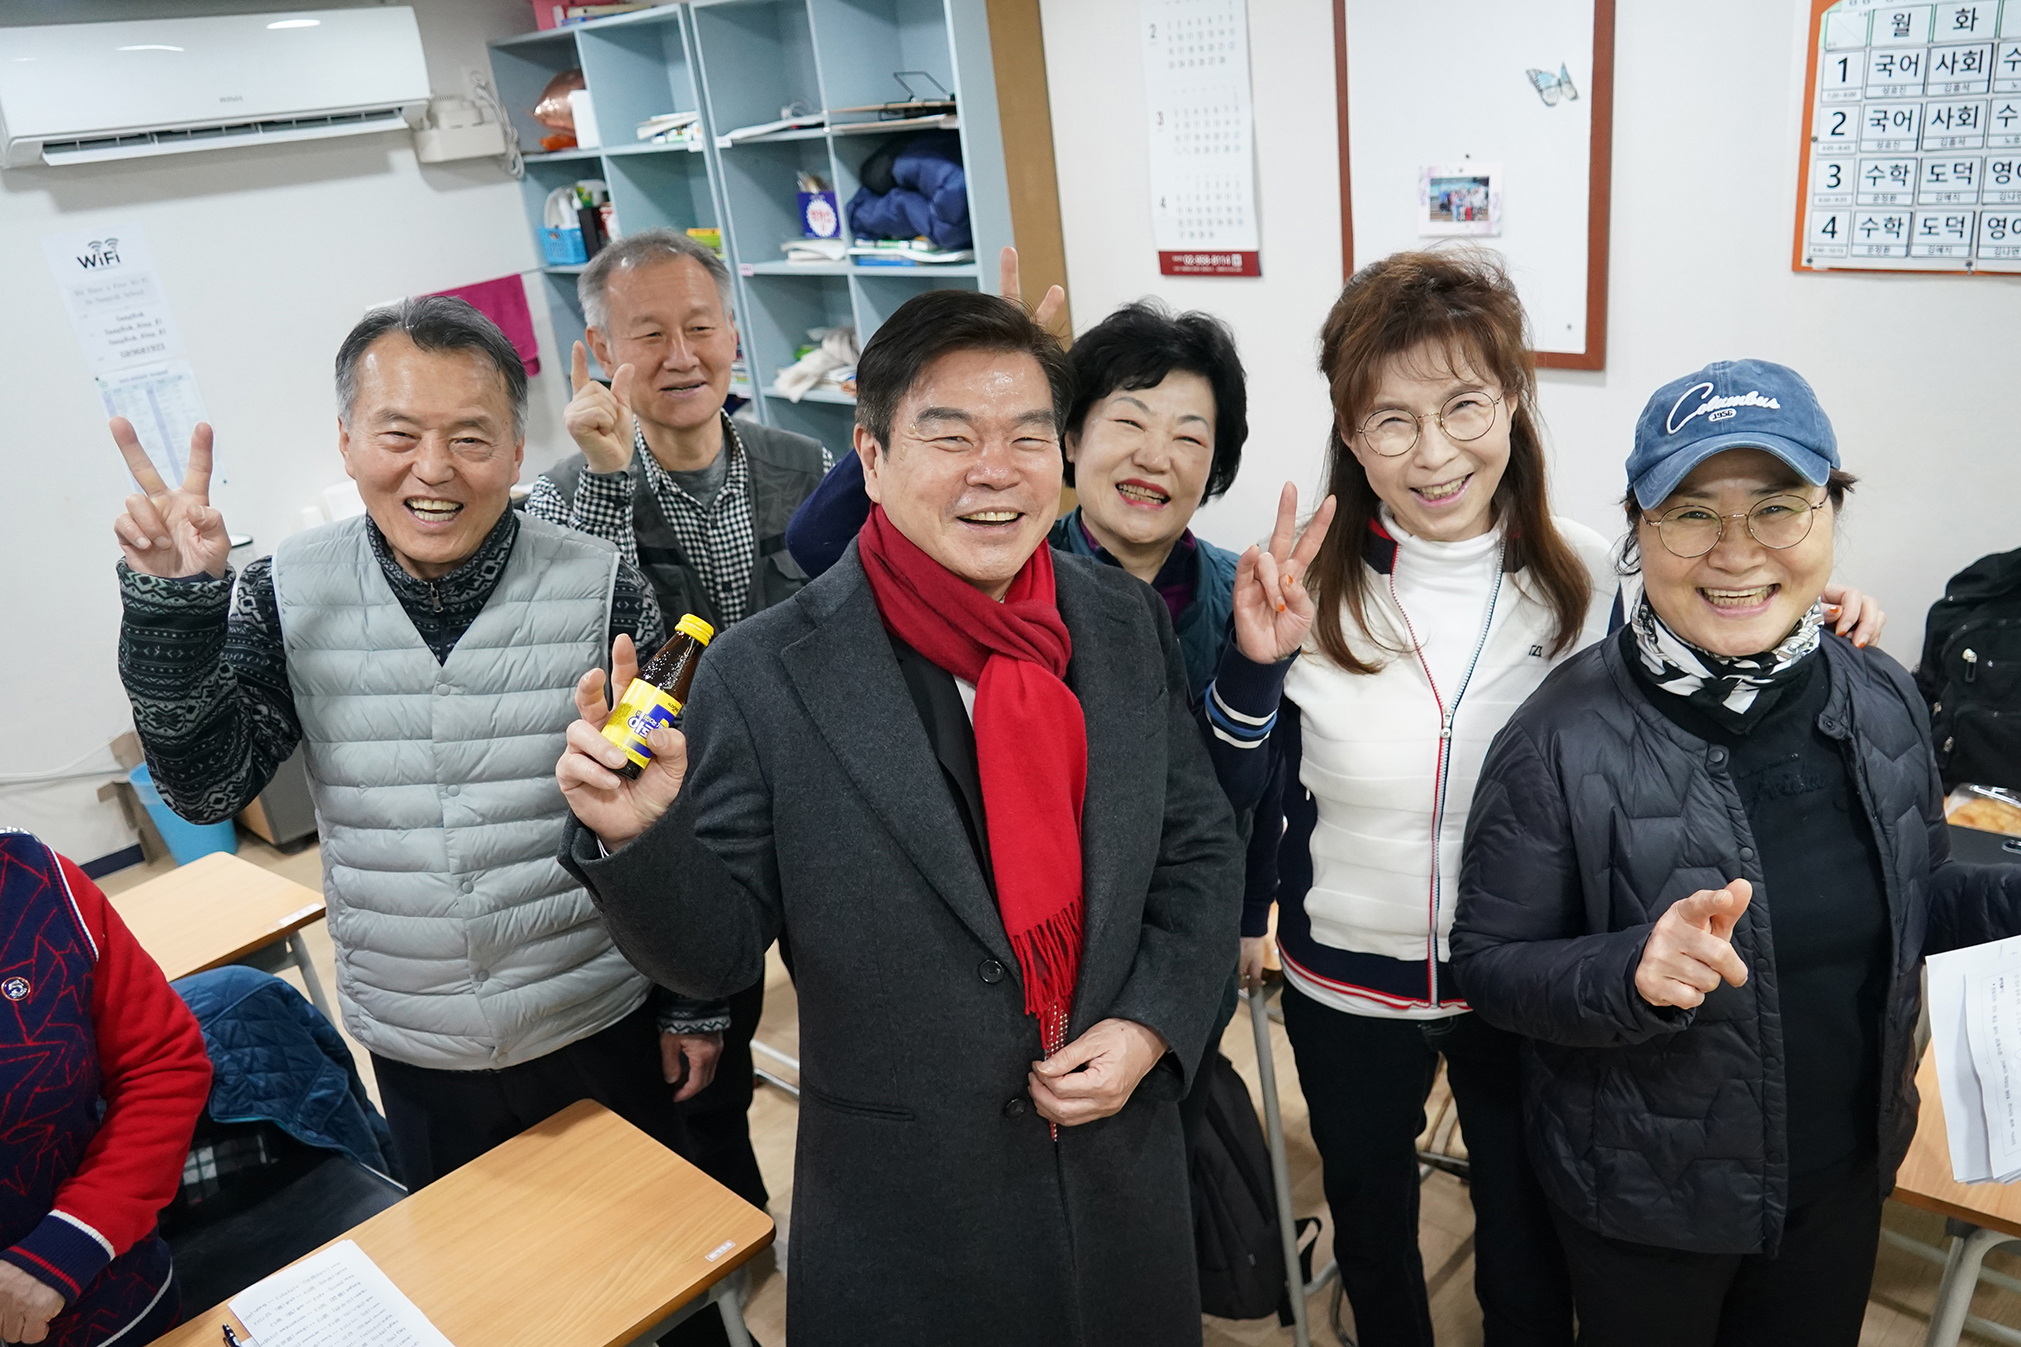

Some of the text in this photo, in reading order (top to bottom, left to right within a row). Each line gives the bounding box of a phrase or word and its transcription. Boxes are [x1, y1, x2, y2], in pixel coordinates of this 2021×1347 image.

[1892, 7, 1978, 37] 월 화
[1837, 57, 1848, 82] 1
[1875, 53, 1920, 77] 국어
[1936, 49, 1983, 75] 사회
[1831, 104, 2018, 136] 2 국어 사회 수
[1827, 160, 2021, 188] 3 수학 도덕 영
[1822, 216, 1837, 239] 4
[1859, 216, 1904, 239] 수학
[1919, 216, 1965, 238] 도덕
[77, 249, 120, 268] WiFi
[1666, 382, 1781, 435] Columbus
[1712, 409, 1733, 420] 1956
